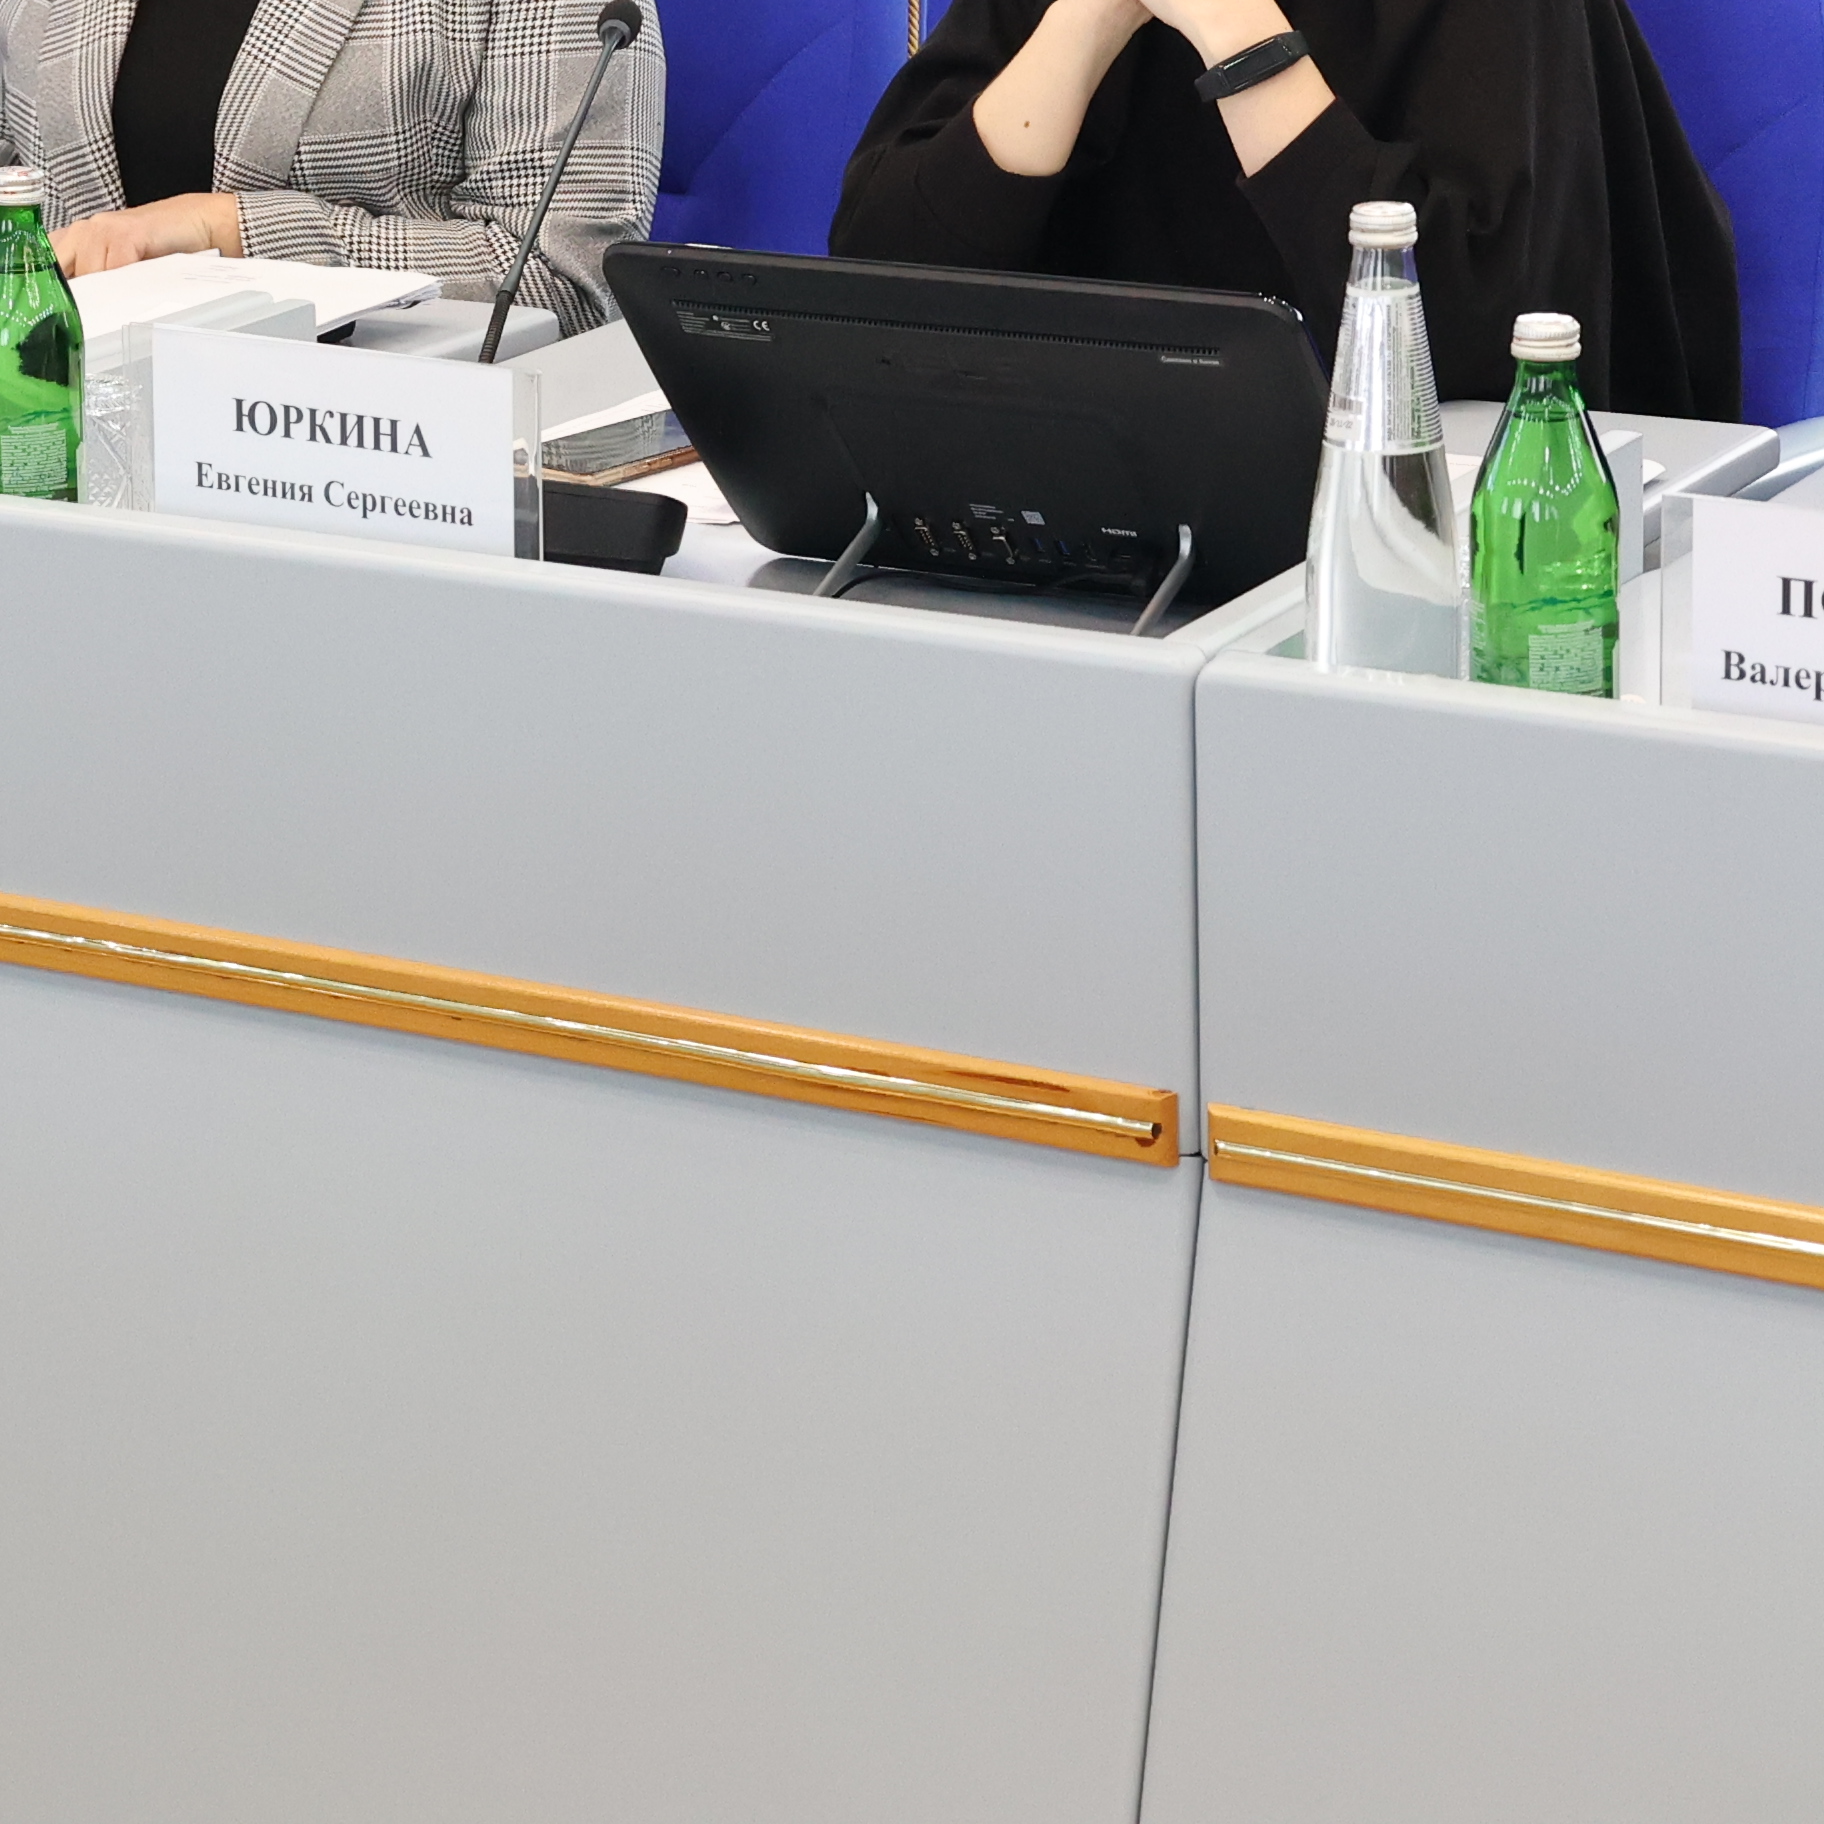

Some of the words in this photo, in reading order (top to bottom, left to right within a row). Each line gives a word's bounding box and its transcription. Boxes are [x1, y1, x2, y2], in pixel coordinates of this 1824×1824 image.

[233, 398, 433, 458] ЮРКИНА
[195, 461, 314, 504] Евгения
[323, 480, 474, 527] Сергеевна
